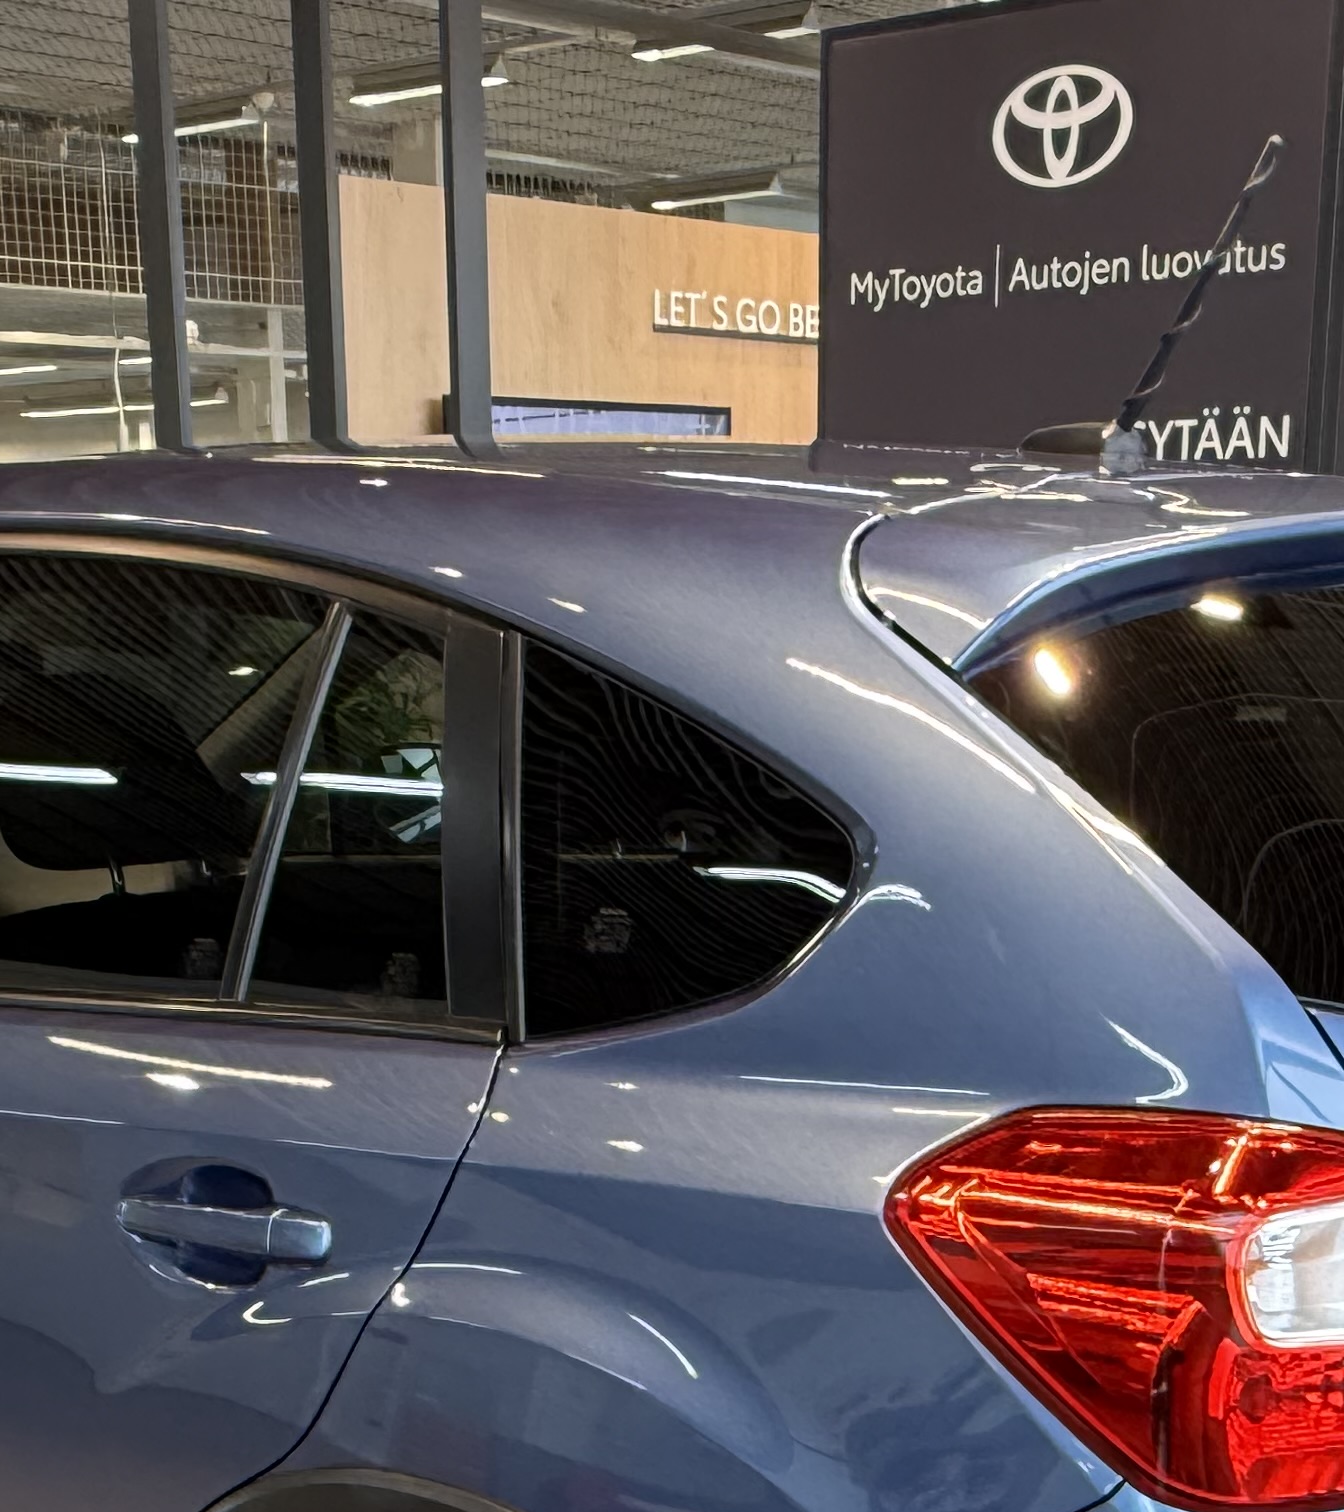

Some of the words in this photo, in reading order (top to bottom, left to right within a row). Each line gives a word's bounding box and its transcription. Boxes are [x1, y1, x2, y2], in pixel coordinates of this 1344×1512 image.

[849, 265, 983, 312] MyToyota
[1008, 250, 1130, 295] Autojen
[736, 297, 781, 335] GO
[1133, 405, 1291, 461] YTÄÄN
